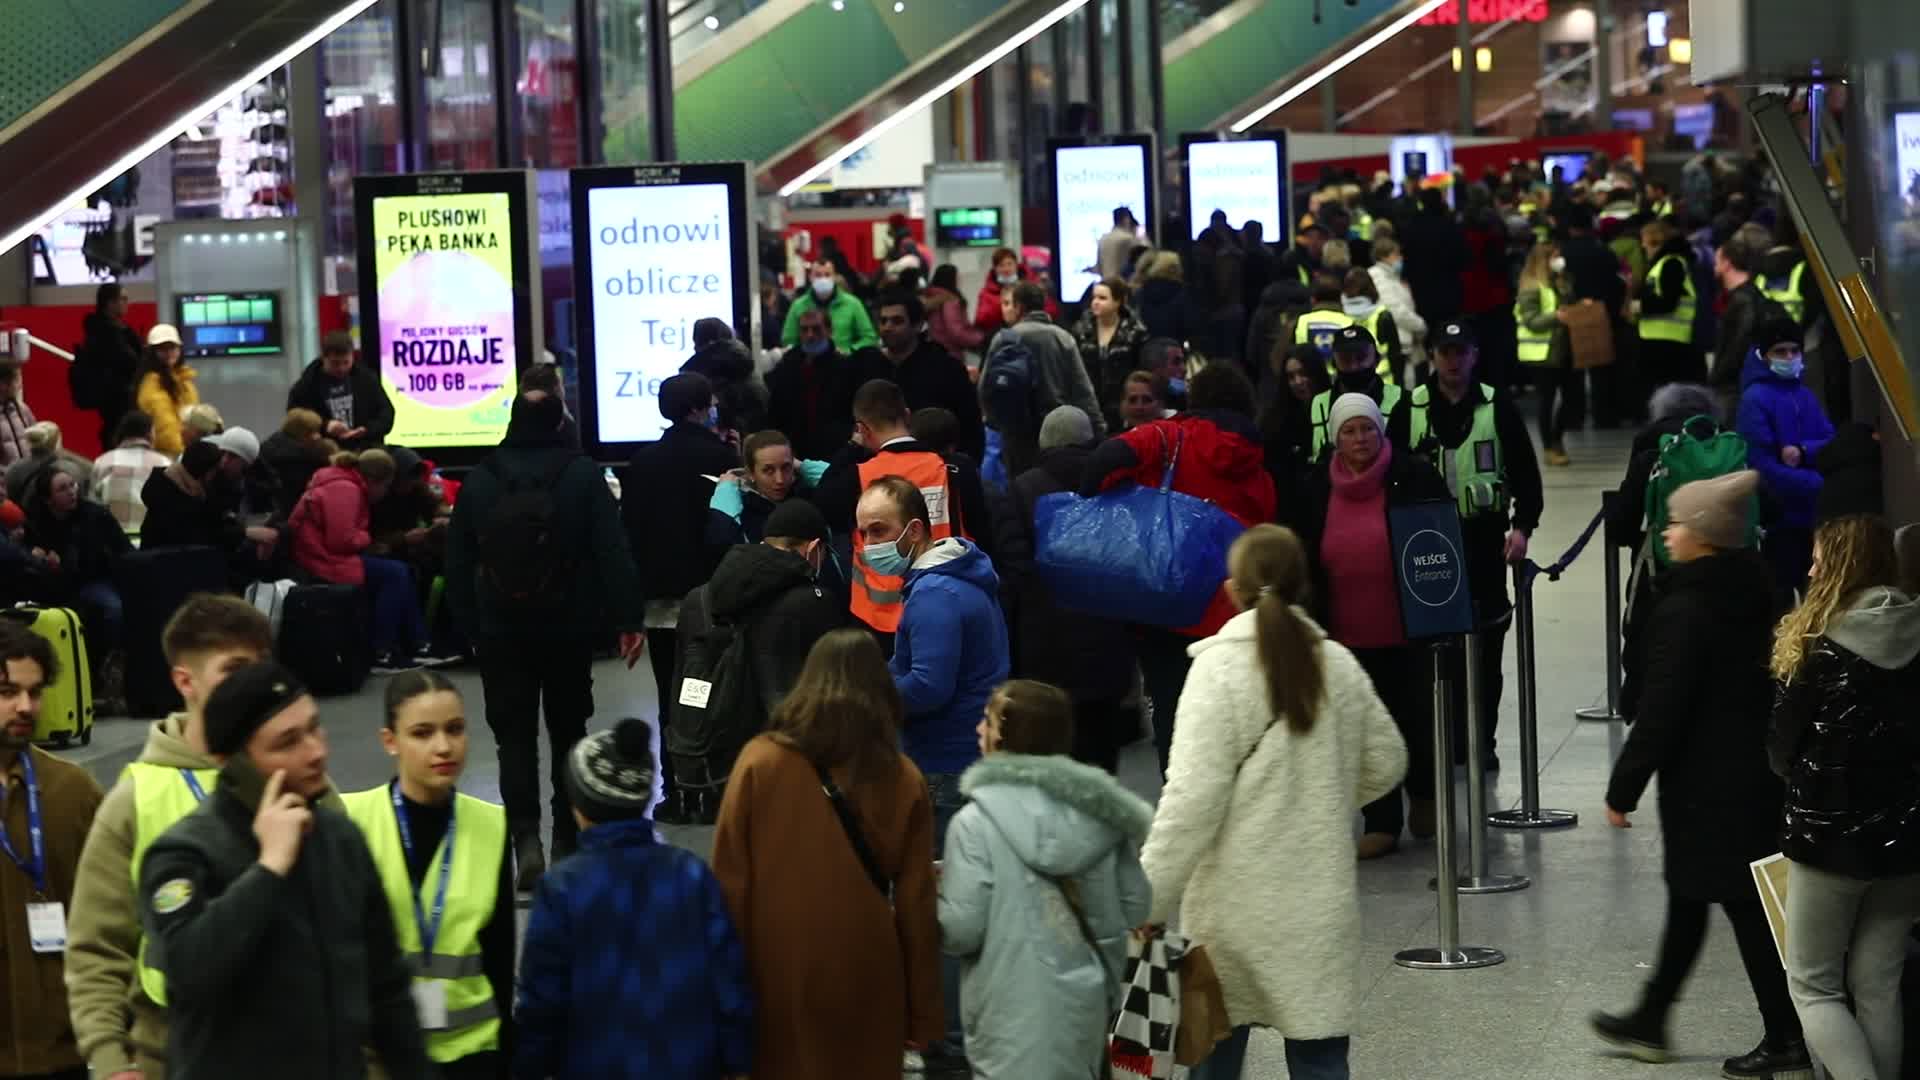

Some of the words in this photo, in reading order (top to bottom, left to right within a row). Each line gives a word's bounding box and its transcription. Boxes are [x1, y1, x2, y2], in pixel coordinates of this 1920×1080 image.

[1467, 0, 1548, 23] KING
[398, 208, 487, 229] PLUSHOWI
[600, 214, 720, 245] odnowi
[387, 235, 433, 255] PĘKA
[439, 232, 498, 251] BANKA
[605, 267, 720, 296] oblicze
[640, 316, 686, 351] Tej
[392, 337, 504, 367] ROZDAJE
[408, 373, 437, 391] 100
[442, 372, 465, 390] GB
[615, 370, 663, 398] Zie
[1413, 553, 1448, 566] WEJŚCIE
[1415, 569, 1452, 582] Entrance
